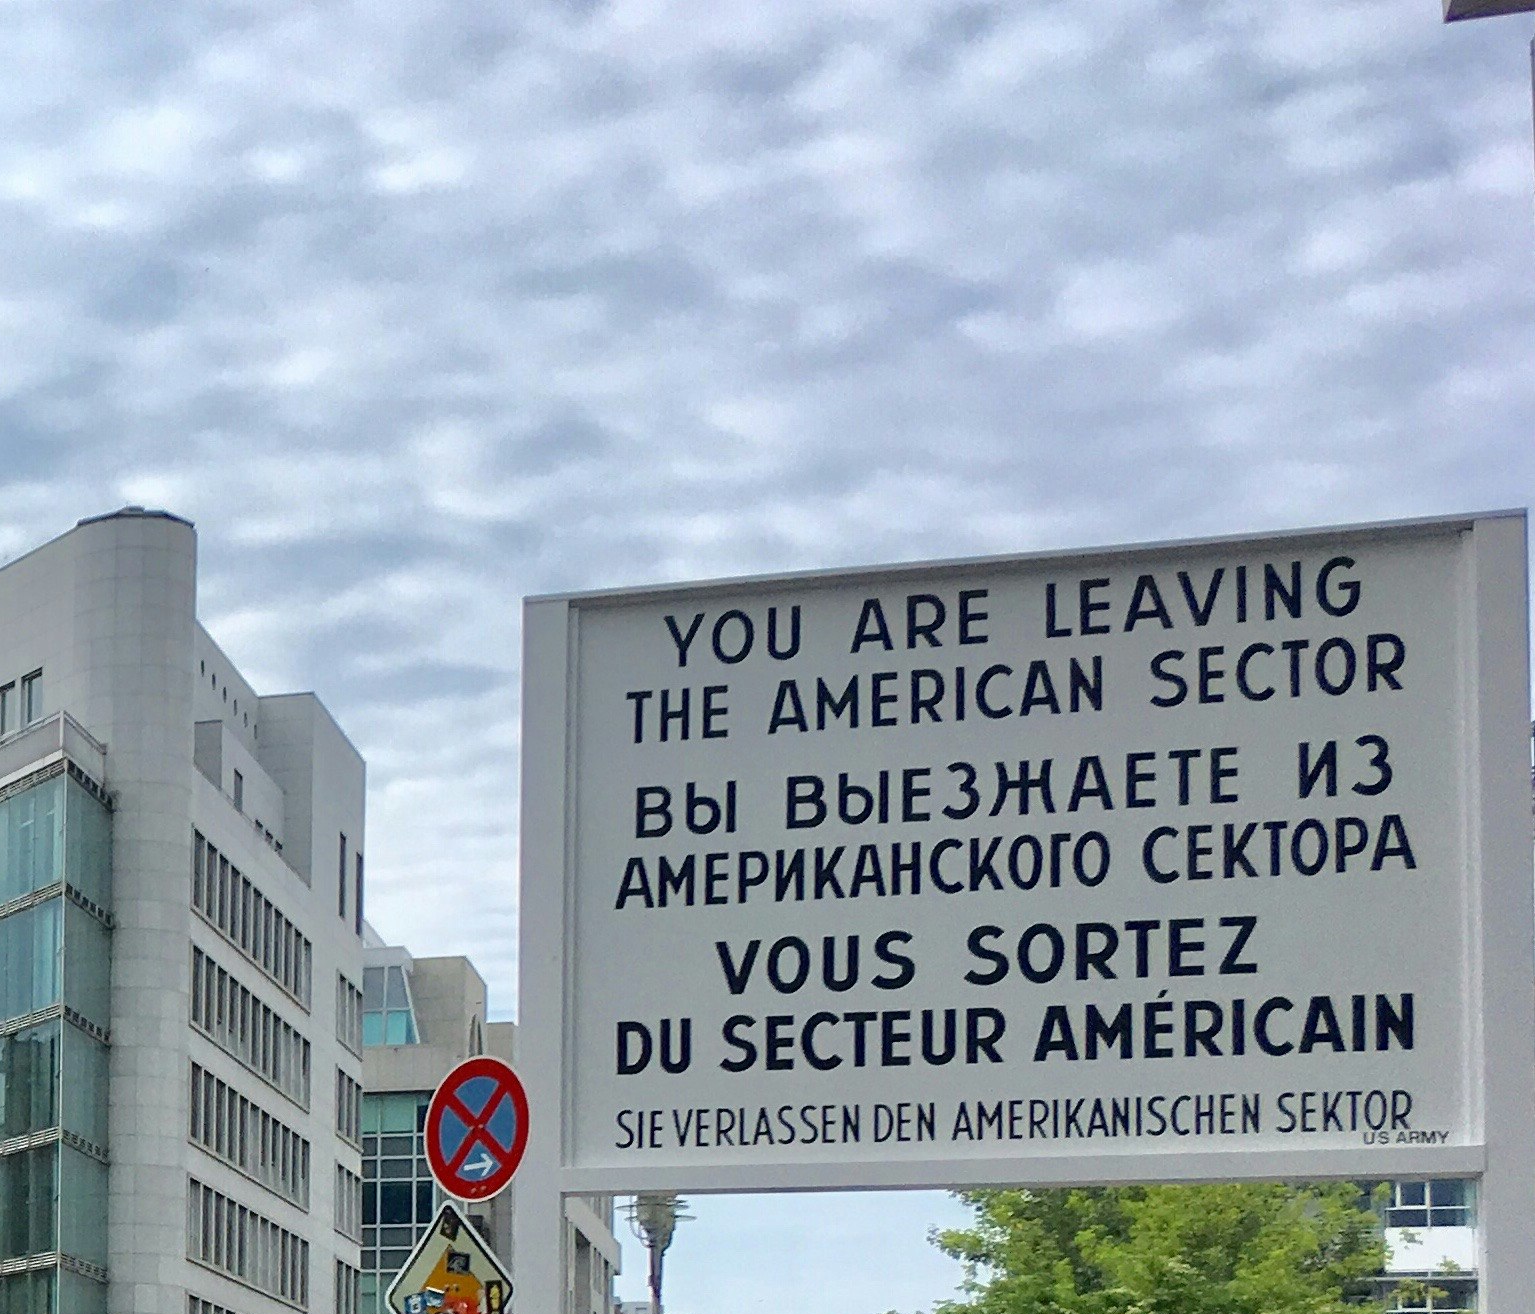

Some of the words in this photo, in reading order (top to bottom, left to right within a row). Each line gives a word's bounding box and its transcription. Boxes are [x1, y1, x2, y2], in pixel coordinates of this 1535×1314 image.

[663, 605, 801, 667] YOU
[850, 589, 989, 654] ARE
[1045, 556, 1362, 638] LEAVING
[626, 685, 729, 744] THE
[767, 655, 1102, 735] AMERICAN
[1149, 633, 1406, 707] SECTOR
[635, 780, 737, 839] ВЫ
[785, 747, 1239, 829] ВЫЕЗЖАЕТЕ
[1298, 734, 1394, 799] ИЗ
[613, 831, 1111, 910] АМЕРИКАНСКОГО
[1142, 814, 1418, 884] СЕКТОРА
[716, 930, 916, 995] VOUS
[964, 915, 1259, 986] SORTEZ
[617, 1018, 692, 1075] DU
[719, 1007, 1007, 1072] SECTEUR
[1033, 989, 1415, 1063] AMÉRICAIN
[615, 1107, 663, 1149] SIE
[672, 1103, 861, 1147] VERLASSEN
[873, 1102, 936, 1143] DEN
[951, 1093, 1261, 1141] AMERIKANISCHEN
[1276, 1089, 1414, 1134] SEKTOR
[1363, 1131, 1390, 1145] US
[1396, 1130, 1449, 1145] ARMY
